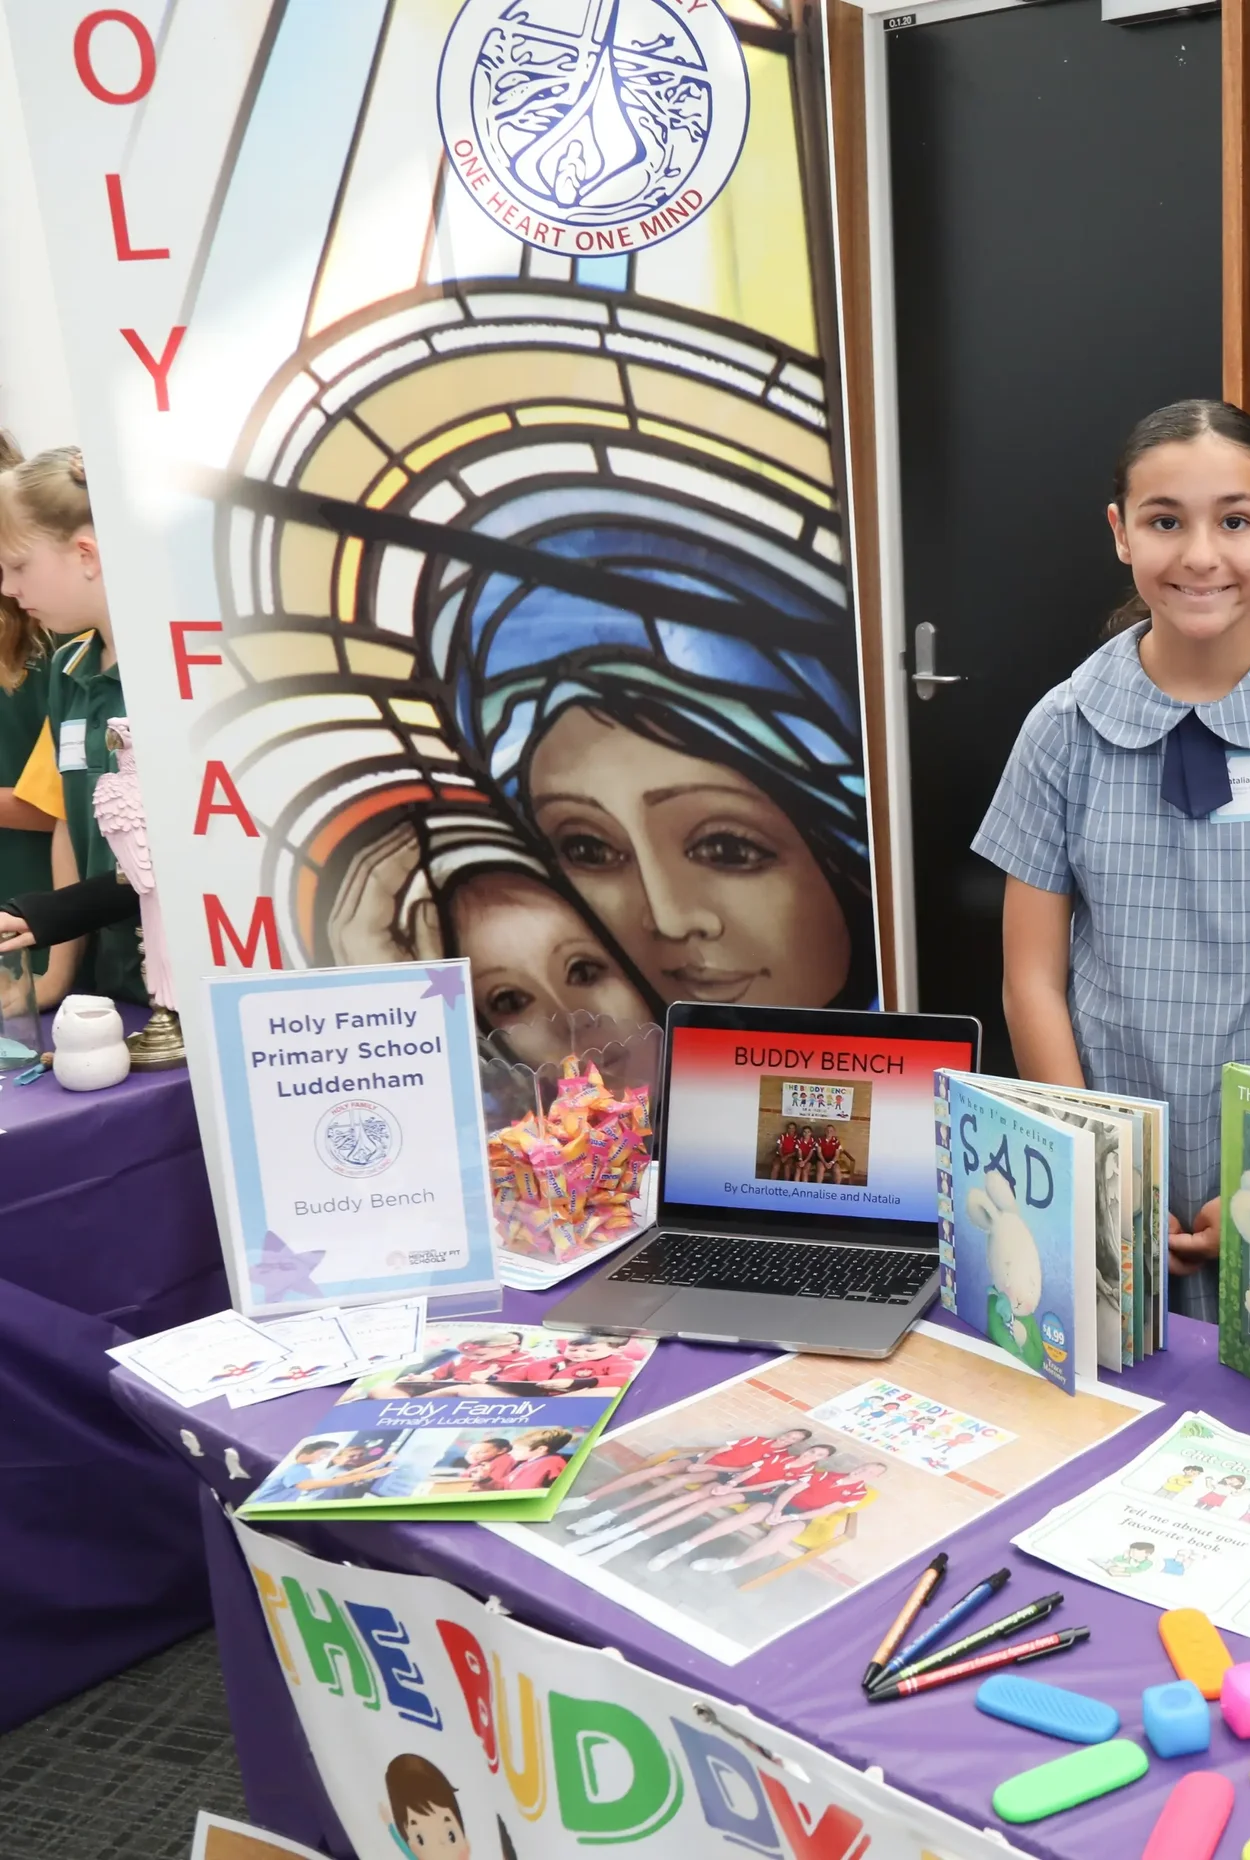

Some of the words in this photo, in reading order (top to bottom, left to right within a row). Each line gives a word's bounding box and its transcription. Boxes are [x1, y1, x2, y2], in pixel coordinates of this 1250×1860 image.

[888, 15, 912, 28] 0.1.20
[454, 139, 491, 191] ONE
[486, 191, 566, 247] HEART
[575, 227, 634, 251] ONE
[639, 188, 704, 240] MIND
[73, 9, 188, 412] OLY
[1229, 776, 1250, 785] atalia
[269, 1015, 325, 1035] Holy
[335, 1007, 417, 1029] Family
[251, 1047, 348, 1068] Primary
[358, 1036, 442, 1059] School
[734, 1046, 815, 1069] BUDDY
[820, 1051, 904, 1075] BENCH
[277, 1072, 424, 1098] Luddenham
[958, 1092, 984, 1115] When
[990, 1108, 1007, 1126] I'm
[1013, 1119, 1054, 1153] Feeling
[959, 1112, 1055, 1209] SAD
[294, 1196, 363, 1215] Buddy
[370, 1188, 435, 1208] Bench
[724, 1182, 738, 1195] By
[840, 1192, 860, 1202] and
[863, 1192, 901, 1205] Natalia
[408, 1257, 447, 1265] SCHOOLS
[1043, 1324, 1065, 1346] $4.99
[376, 1416, 436, 1427] Primary
[437, 1415, 530, 1426] Luddenham
[378, 1401, 448, 1419] Holy
[451, 1401, 547, 1419] Family
[1181, 1448, 1220, 1465] Chit
[1118, 1517, 1185, 1541] favourite
[1123, 1504, 1148, 1518] Tell
[1148, 1513, 1170, 1524] me
[1172, 1521, 1213, 1537] about
[1214, 1534, 1250, 1547] your
[251, 1564, 443, 1731] THE
[435, 1618, 871, 1860] BUDDY
